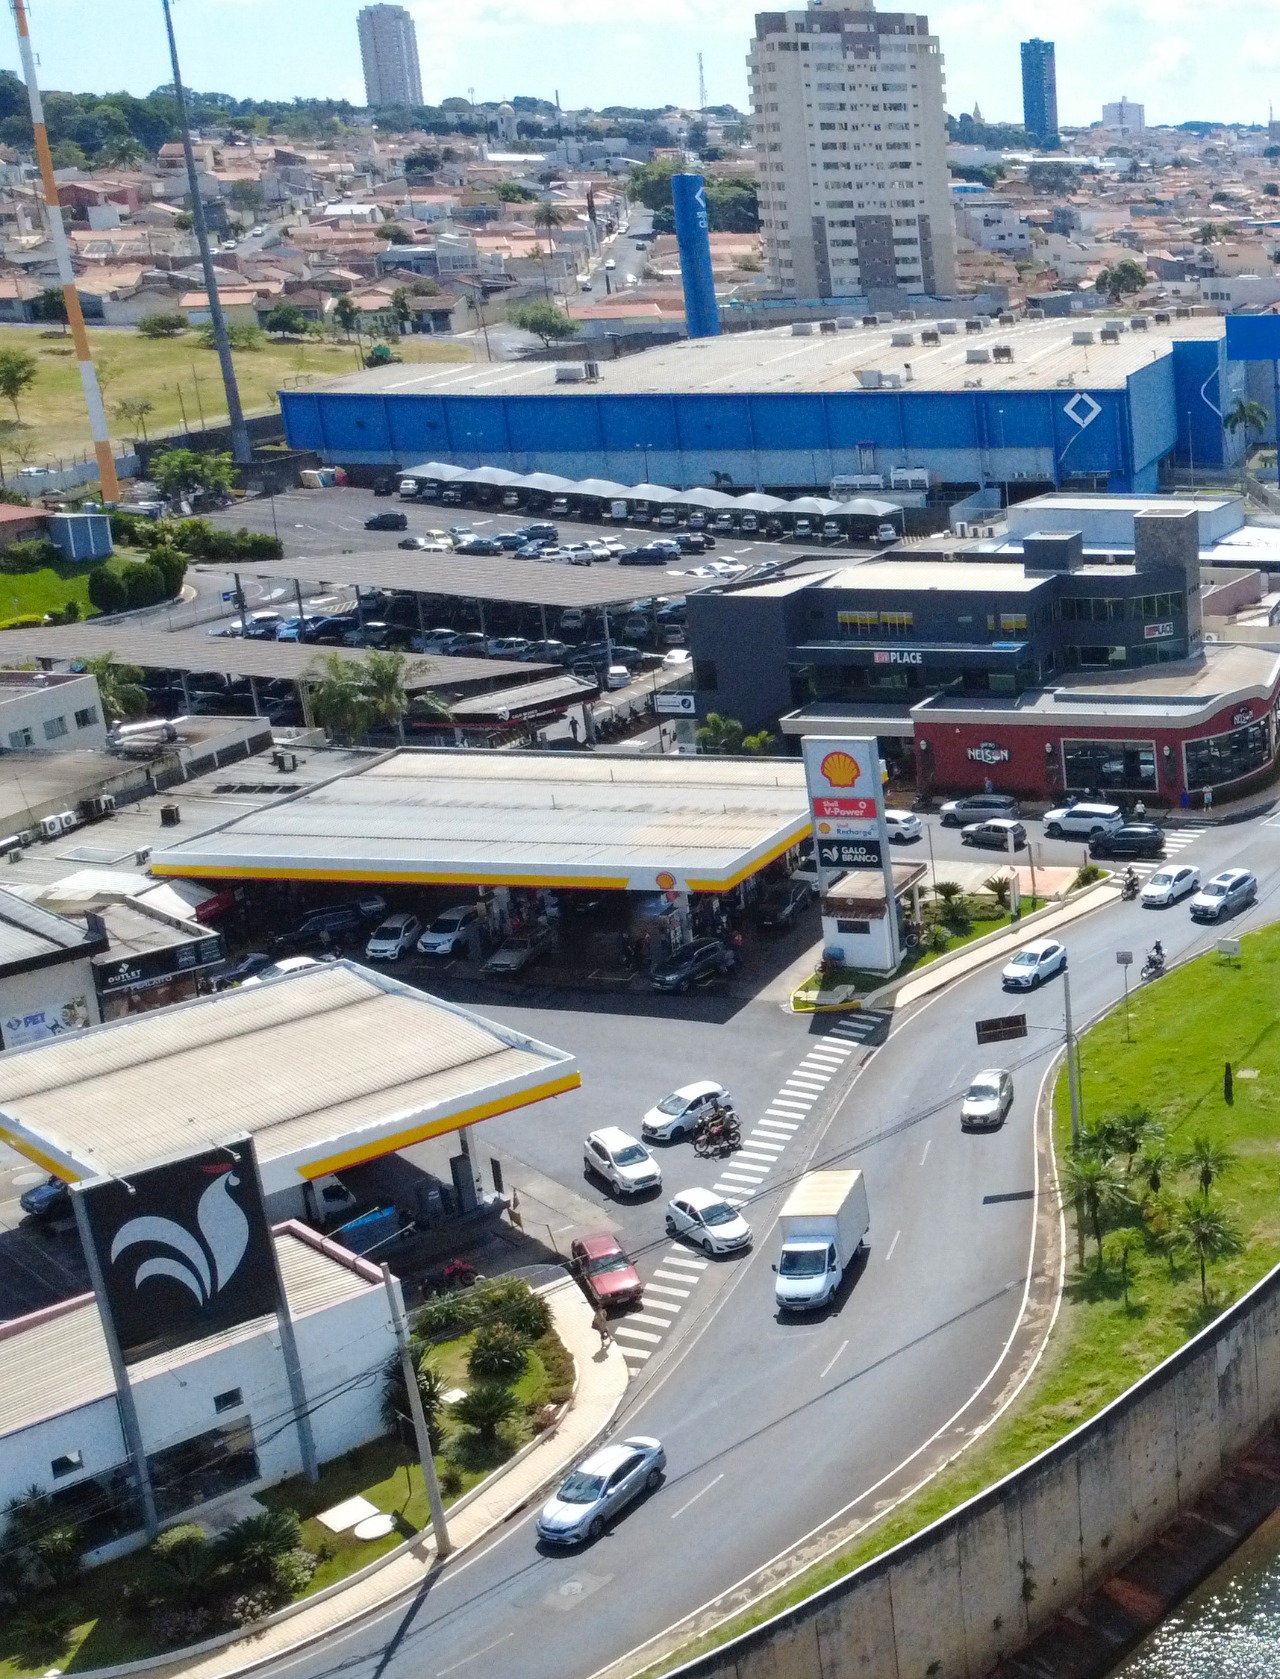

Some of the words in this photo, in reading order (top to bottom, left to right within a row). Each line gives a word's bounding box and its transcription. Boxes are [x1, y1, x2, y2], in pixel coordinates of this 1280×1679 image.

[890, 652, 923, 664] PLACE
[967, 747, 1009, 764] NELSON
[842, 854, 878, 862] BRANCO
[107, 969, 142, 983] OUTLET
[23, 1011, 46, 1028] PET
